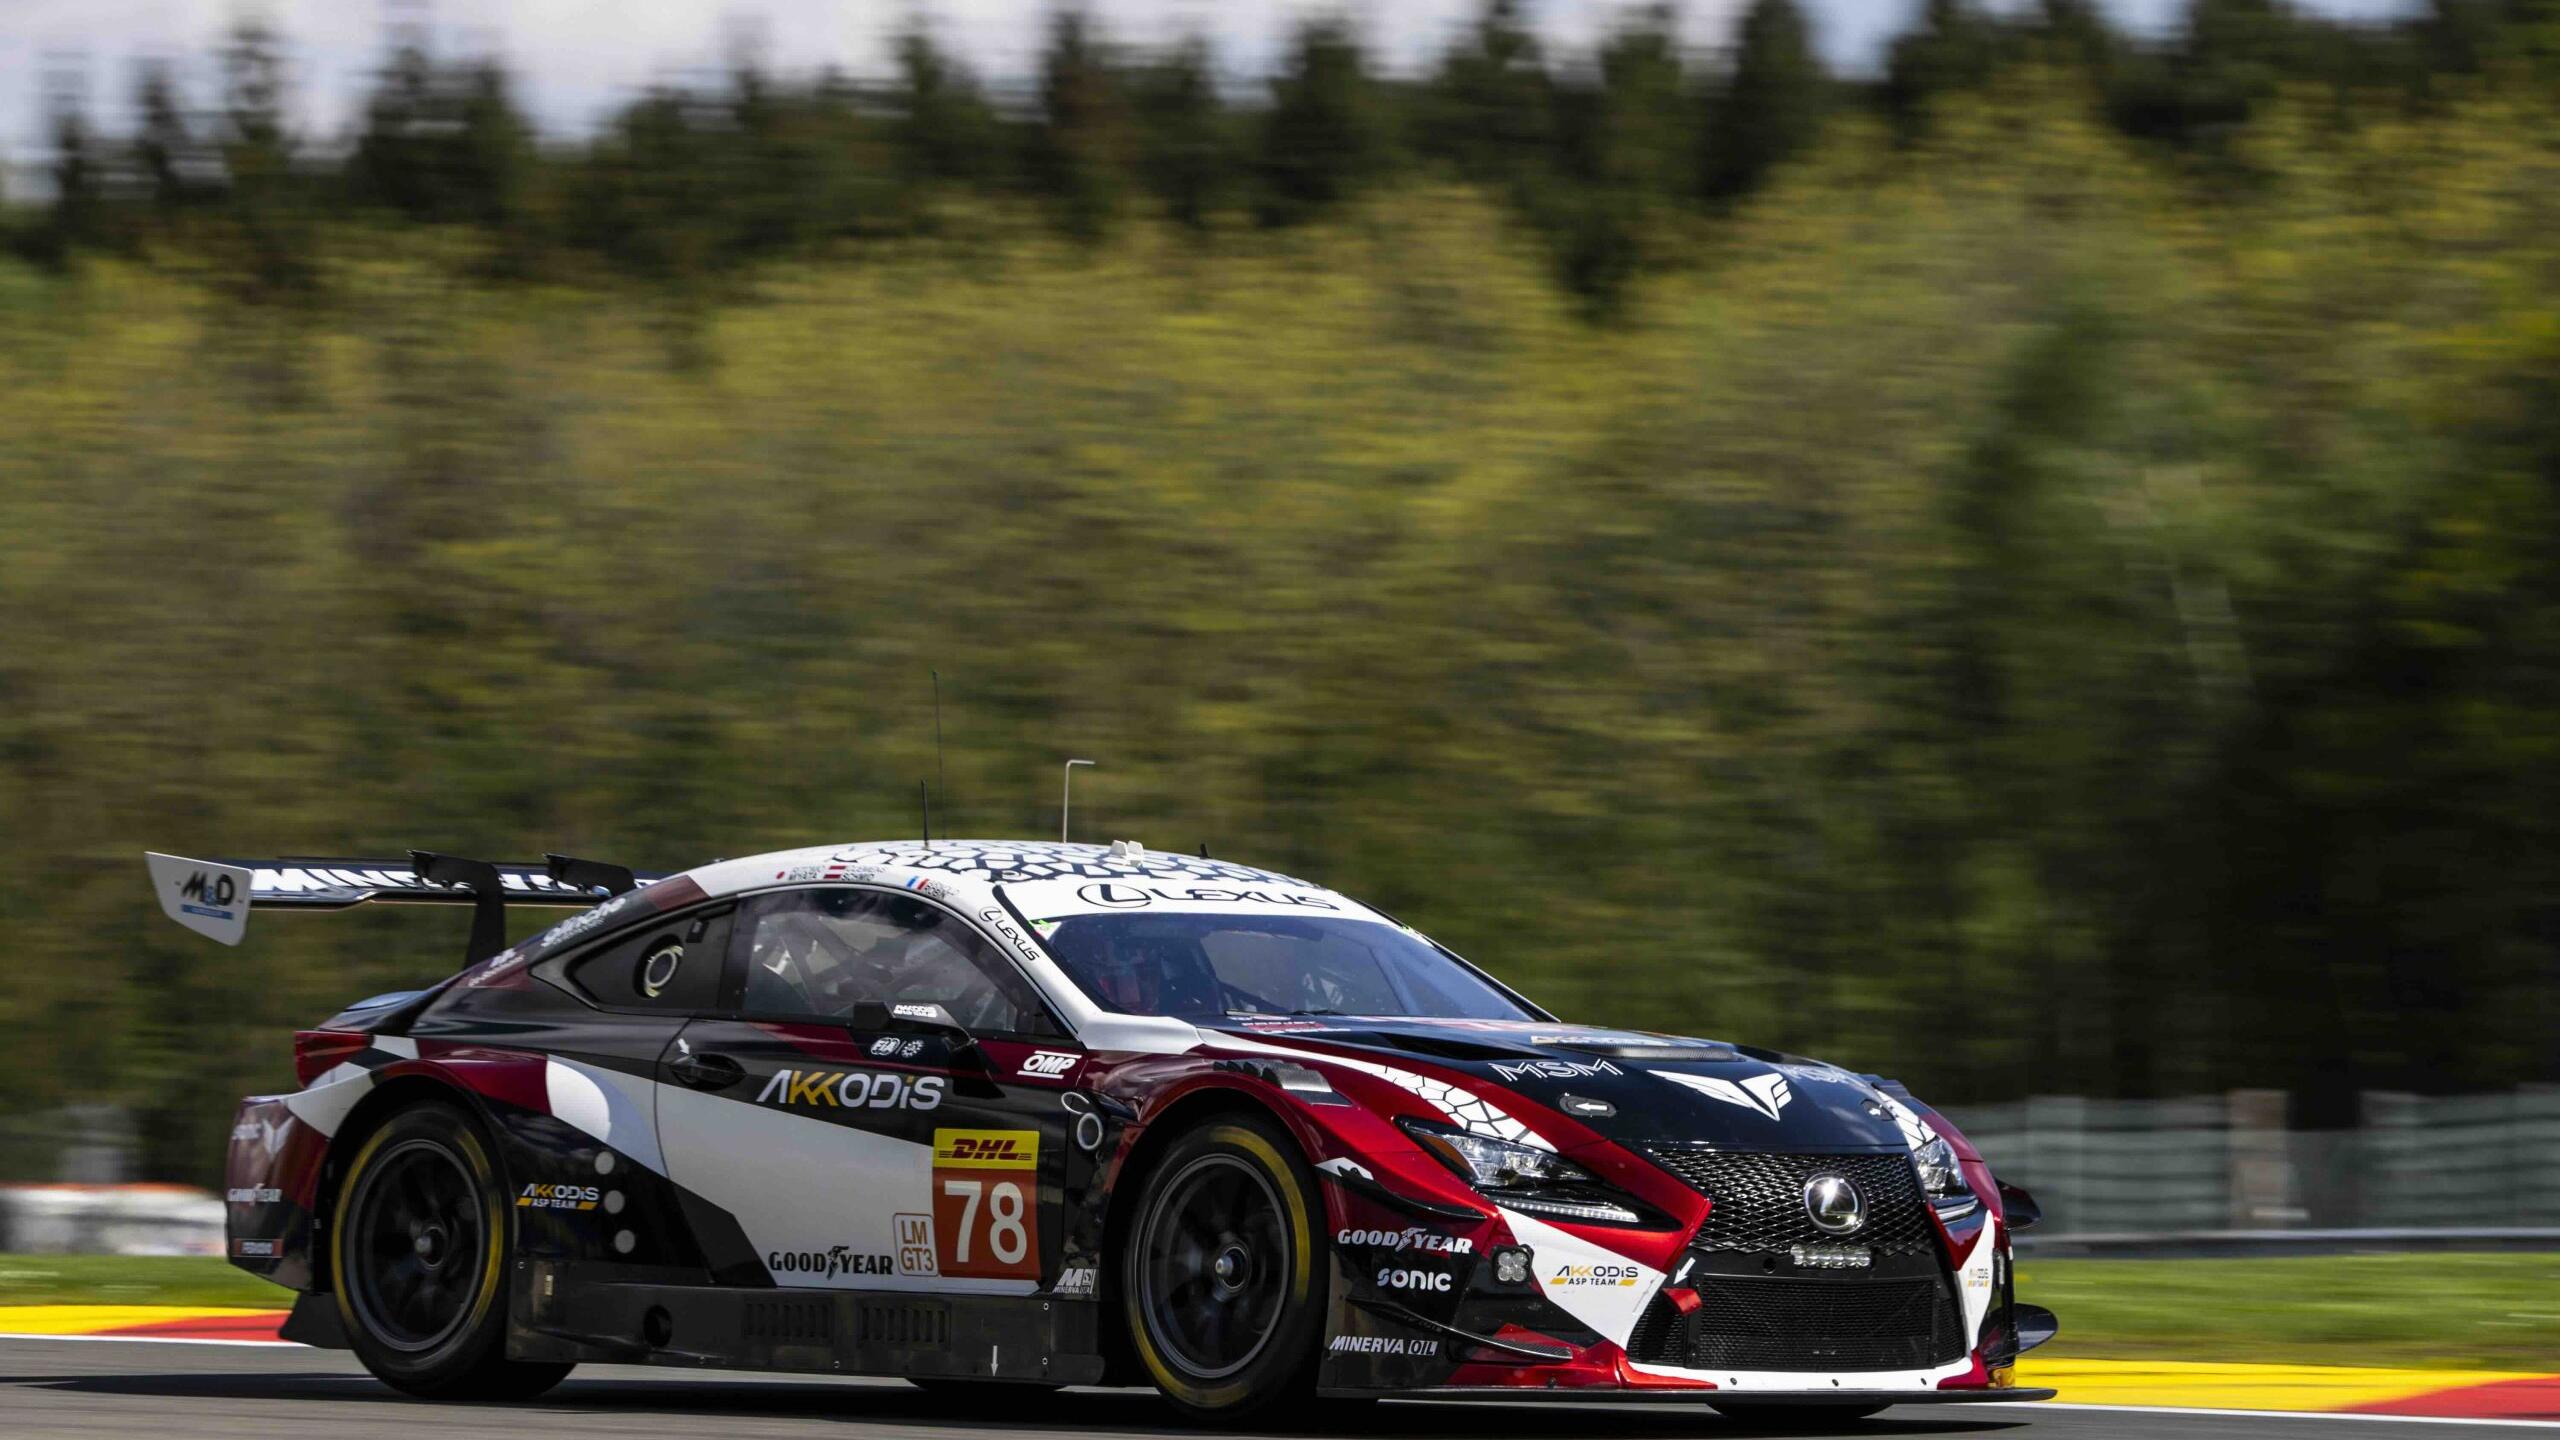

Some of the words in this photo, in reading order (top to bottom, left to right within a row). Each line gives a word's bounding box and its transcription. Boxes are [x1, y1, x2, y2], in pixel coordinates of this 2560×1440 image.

[1149, 888, 1341, 911] LEXUS
[995, 920, 1040, 961] LEXUS
[1023, 1054, 1077, 1074] OMP
[1487, 1058, 1624, 1082] MSM
[951, 1138, 1020, 1161] DHL
[531, 1198, 550, 1208] ASP
[900, 1220, 929, 1245] LM
[944, 1180, 1028, 1265] 78
[900, 1246, 934, 1272] GT3
[1568, 1278, 1588, 1286] ASP
[1590, 1278, 1616, 1286] TEAM
[1329, 1335, 1404, 1354] MINERVA
[1408, 1340, 1438, 1356] OIL
